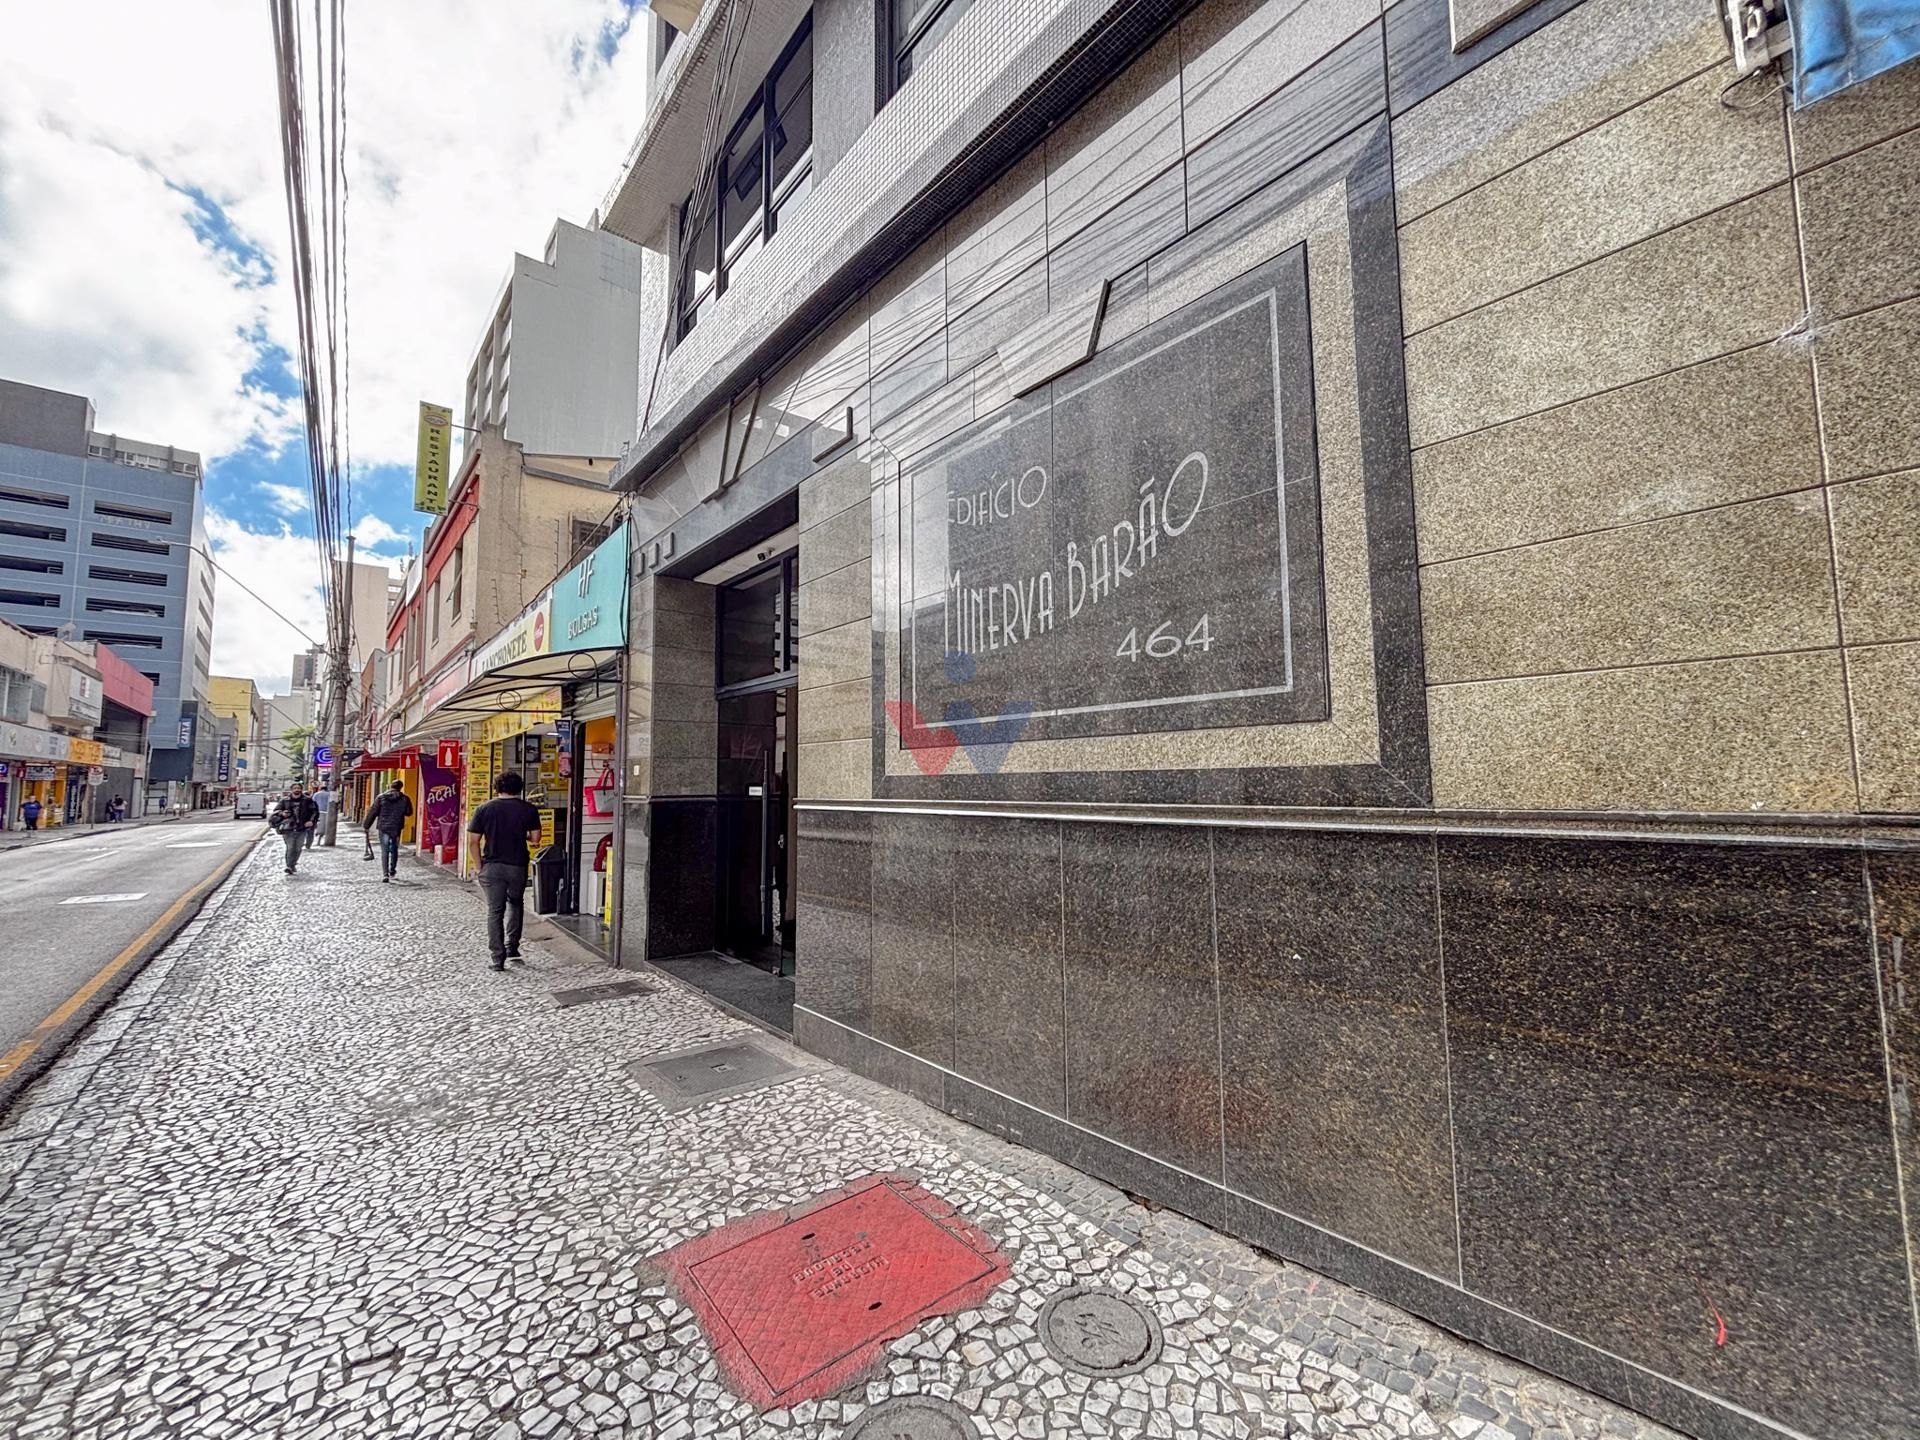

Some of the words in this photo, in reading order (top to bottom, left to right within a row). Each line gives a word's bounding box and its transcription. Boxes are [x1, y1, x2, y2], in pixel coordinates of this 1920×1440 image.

[427, 428, 441, 511] RESTAURANTE
[946, 465, 1048, 527] EDIFÍCIO
[577, 554, 596, 599] HF
[944, 568, 1054, 657] MINERVA
[1066, 450, 1209, 620] BARÃO
[568, 606, 599, 641] BOLSAS
[1116, 613, 1215, 663] 464
